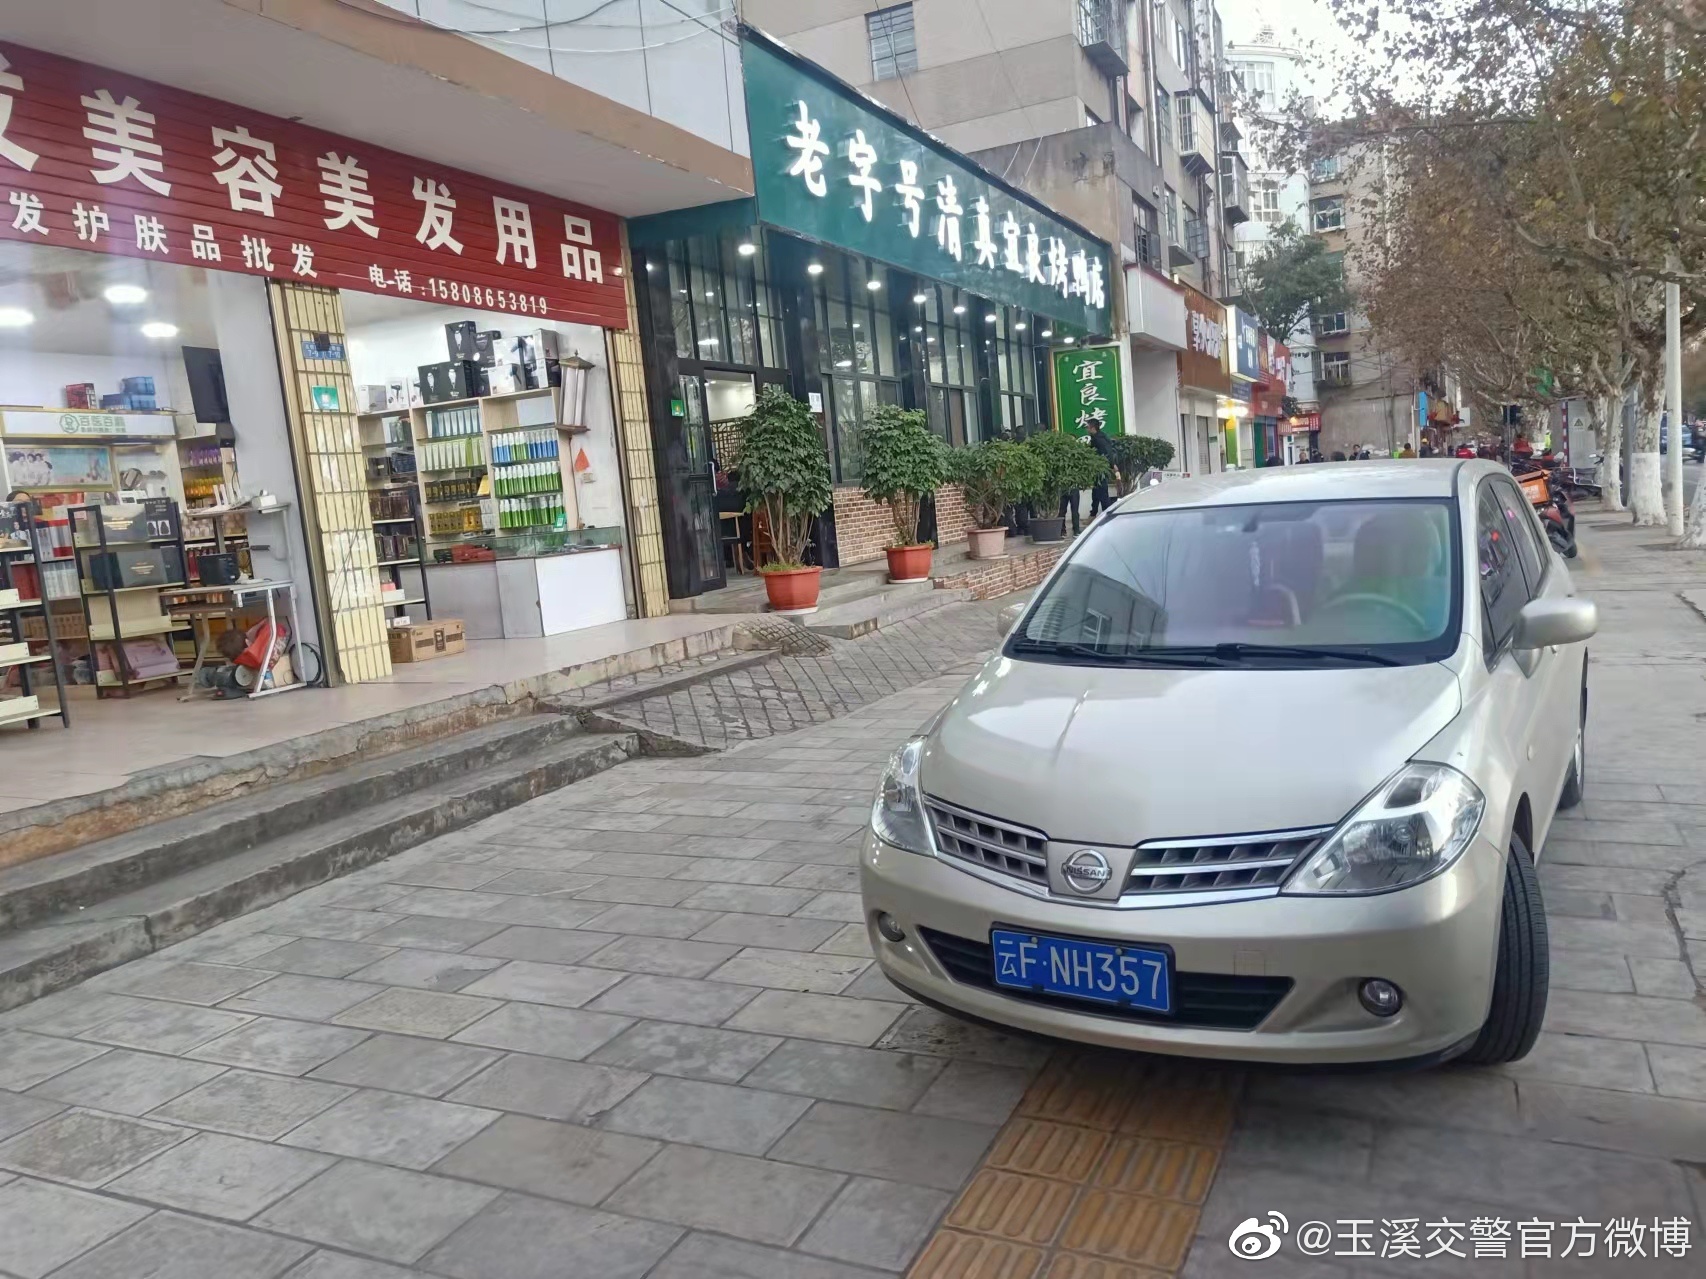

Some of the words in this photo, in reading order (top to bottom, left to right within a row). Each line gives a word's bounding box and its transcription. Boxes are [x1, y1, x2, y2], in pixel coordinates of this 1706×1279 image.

[8, 190, 318, 279] 发护肤品批发
[1072, 360, 1108, 444] 宜良烤
[1066, 866, 1106, 877] NISSAN
